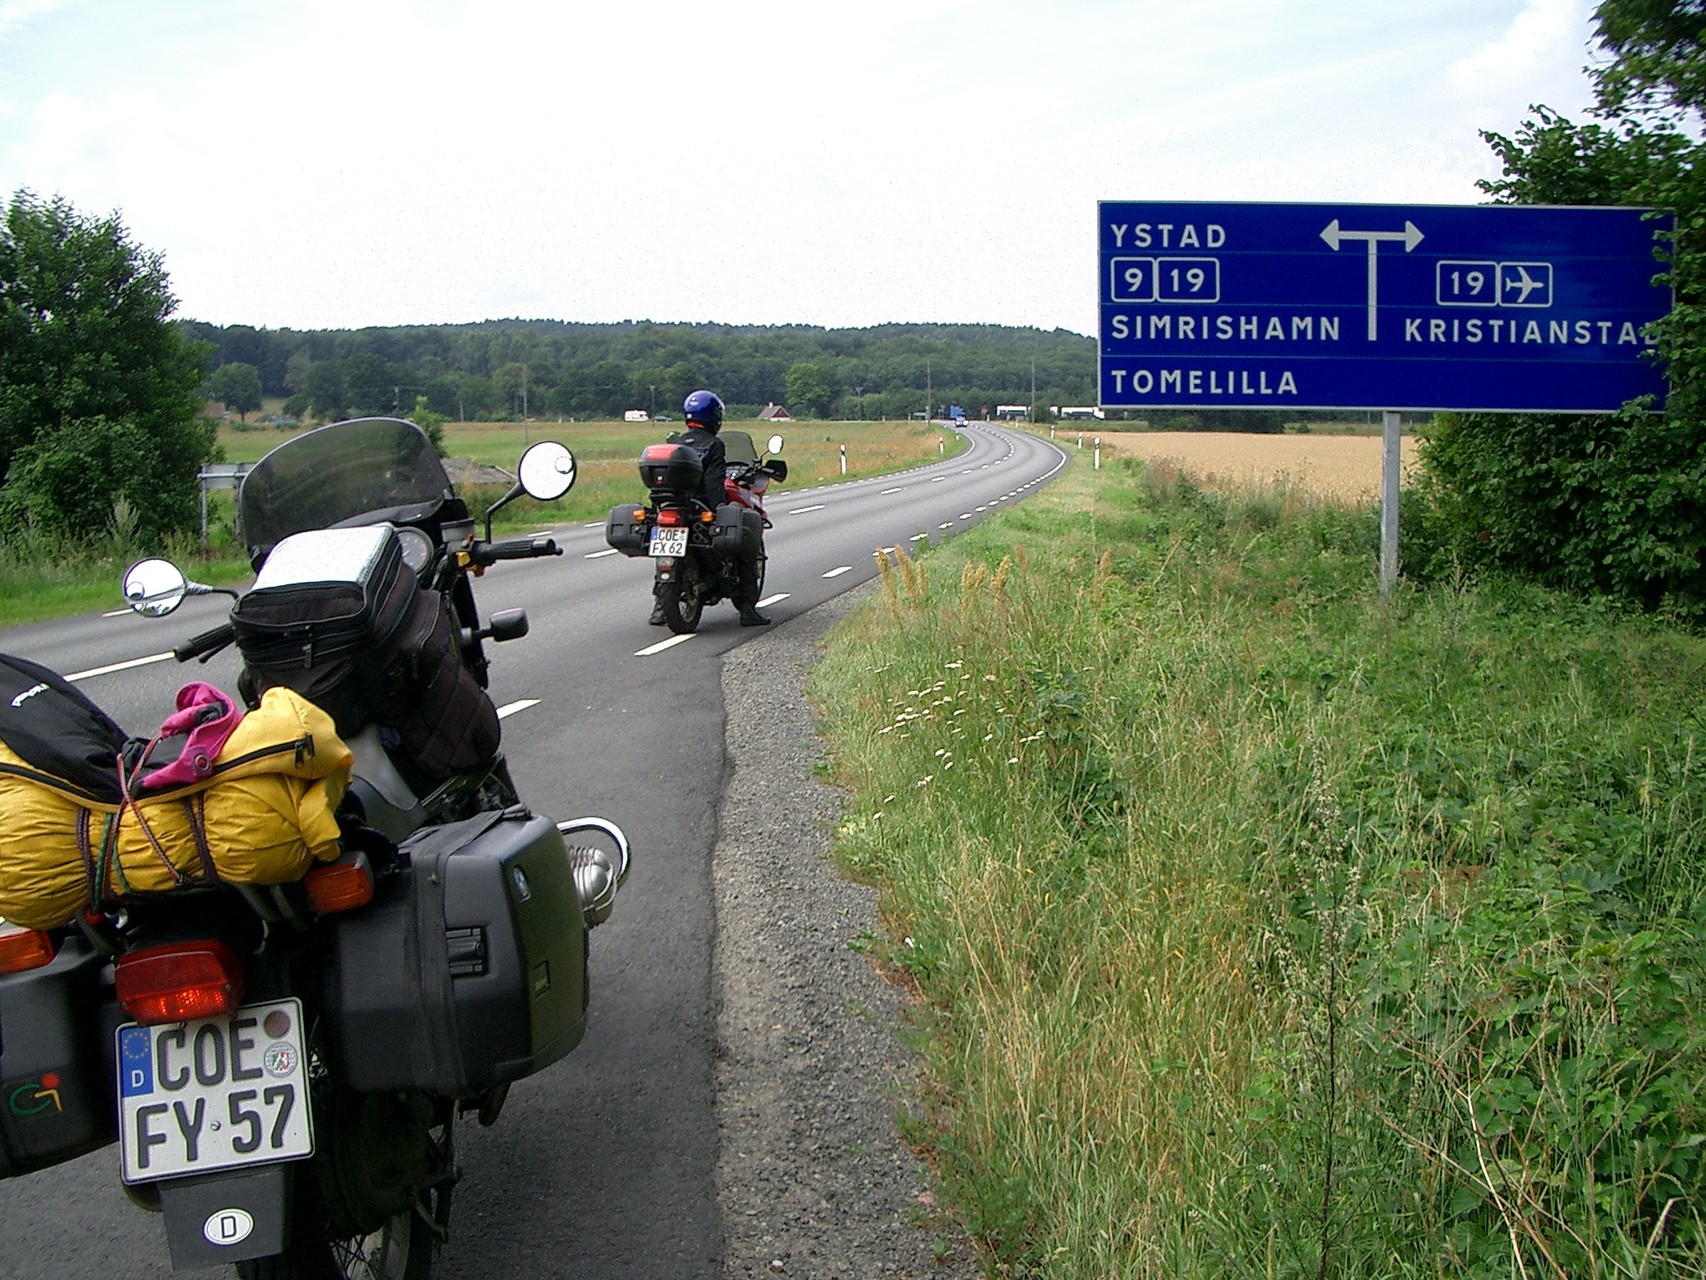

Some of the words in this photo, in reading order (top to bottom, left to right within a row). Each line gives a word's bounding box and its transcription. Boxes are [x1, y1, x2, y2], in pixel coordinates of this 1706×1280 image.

[1112, 224, 1226, 248] YSTAD
[1125, 268, 1143, 292] 9
[1170, 268, 1205, 292] 19
[1451, 271, 1485, 295] 19
[1112, 314, 1340, 341] SIMRISHAMN
[1111, 369, 1298, 395] TOMELILLA
[658, 529, 680, 541] COE
[652, 541, 667, 554] FX
[669, 542, 683, 555] 62
[156, 1017, 263, 1091] COE
[131, 1070, 145, 1088] D
[136, 1097, 206, 1169] FY
[228, 1084, 295, 1154] 57
[220, 1216, 237, 1239] D
